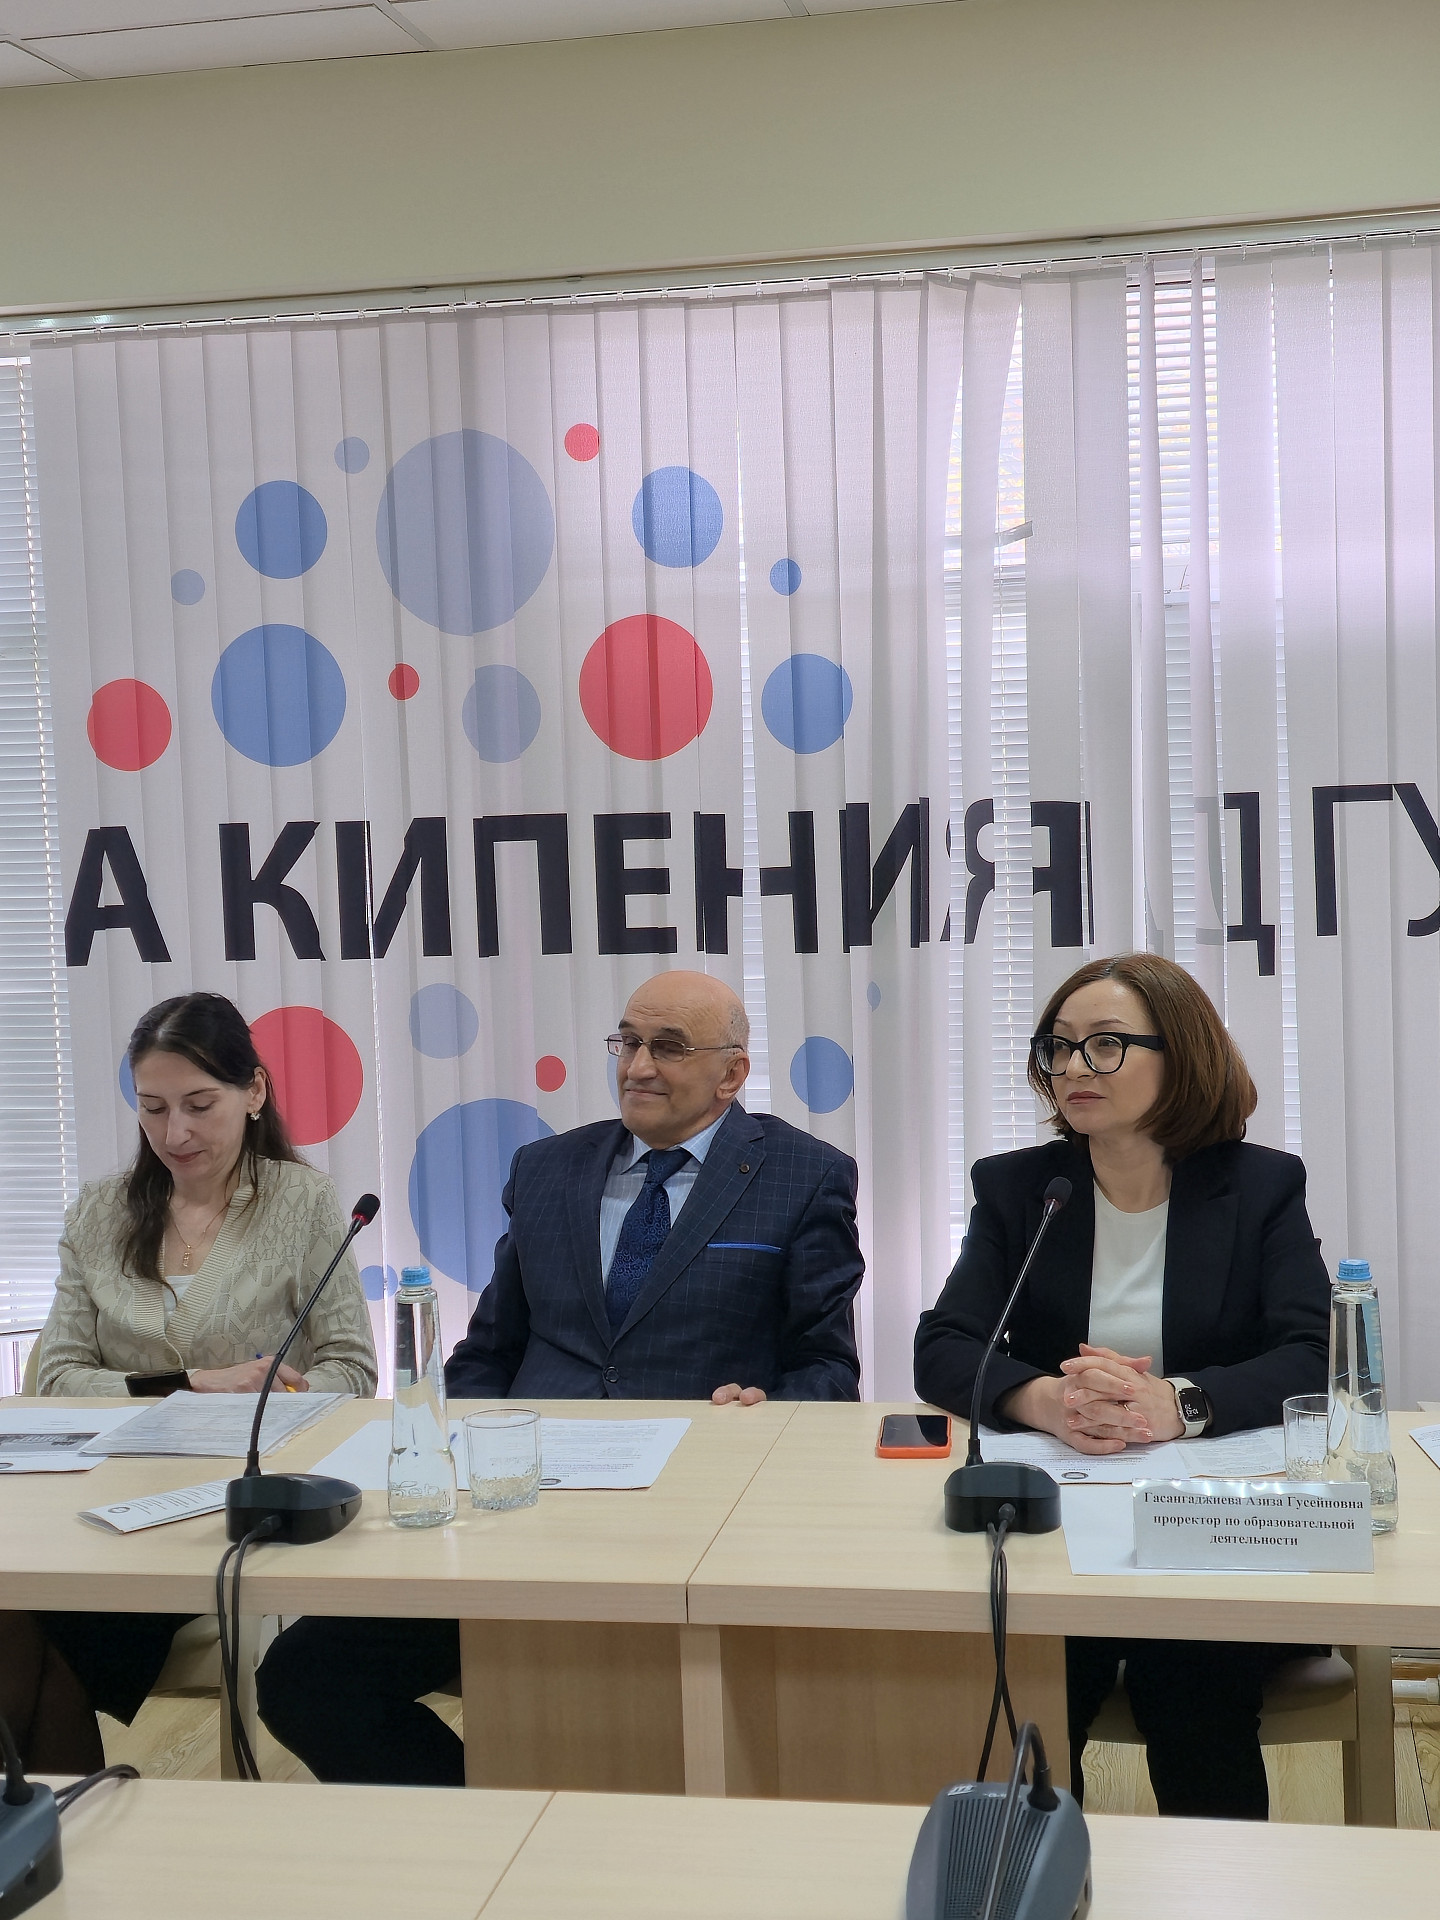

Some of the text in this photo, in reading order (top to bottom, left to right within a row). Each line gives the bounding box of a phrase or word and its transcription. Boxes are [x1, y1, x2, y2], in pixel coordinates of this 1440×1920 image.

[64, 826, 172, 966] А
[219, 797, 1095, 962] КИПЕНИЯ
[1144, 1491, 1364, 1510] Гасангаджиева Азиза Гусейновна
[1153, 1515, 1355, 1530] проректор по образовательной
[1209, 1535, 1298, 1546] деятельности
